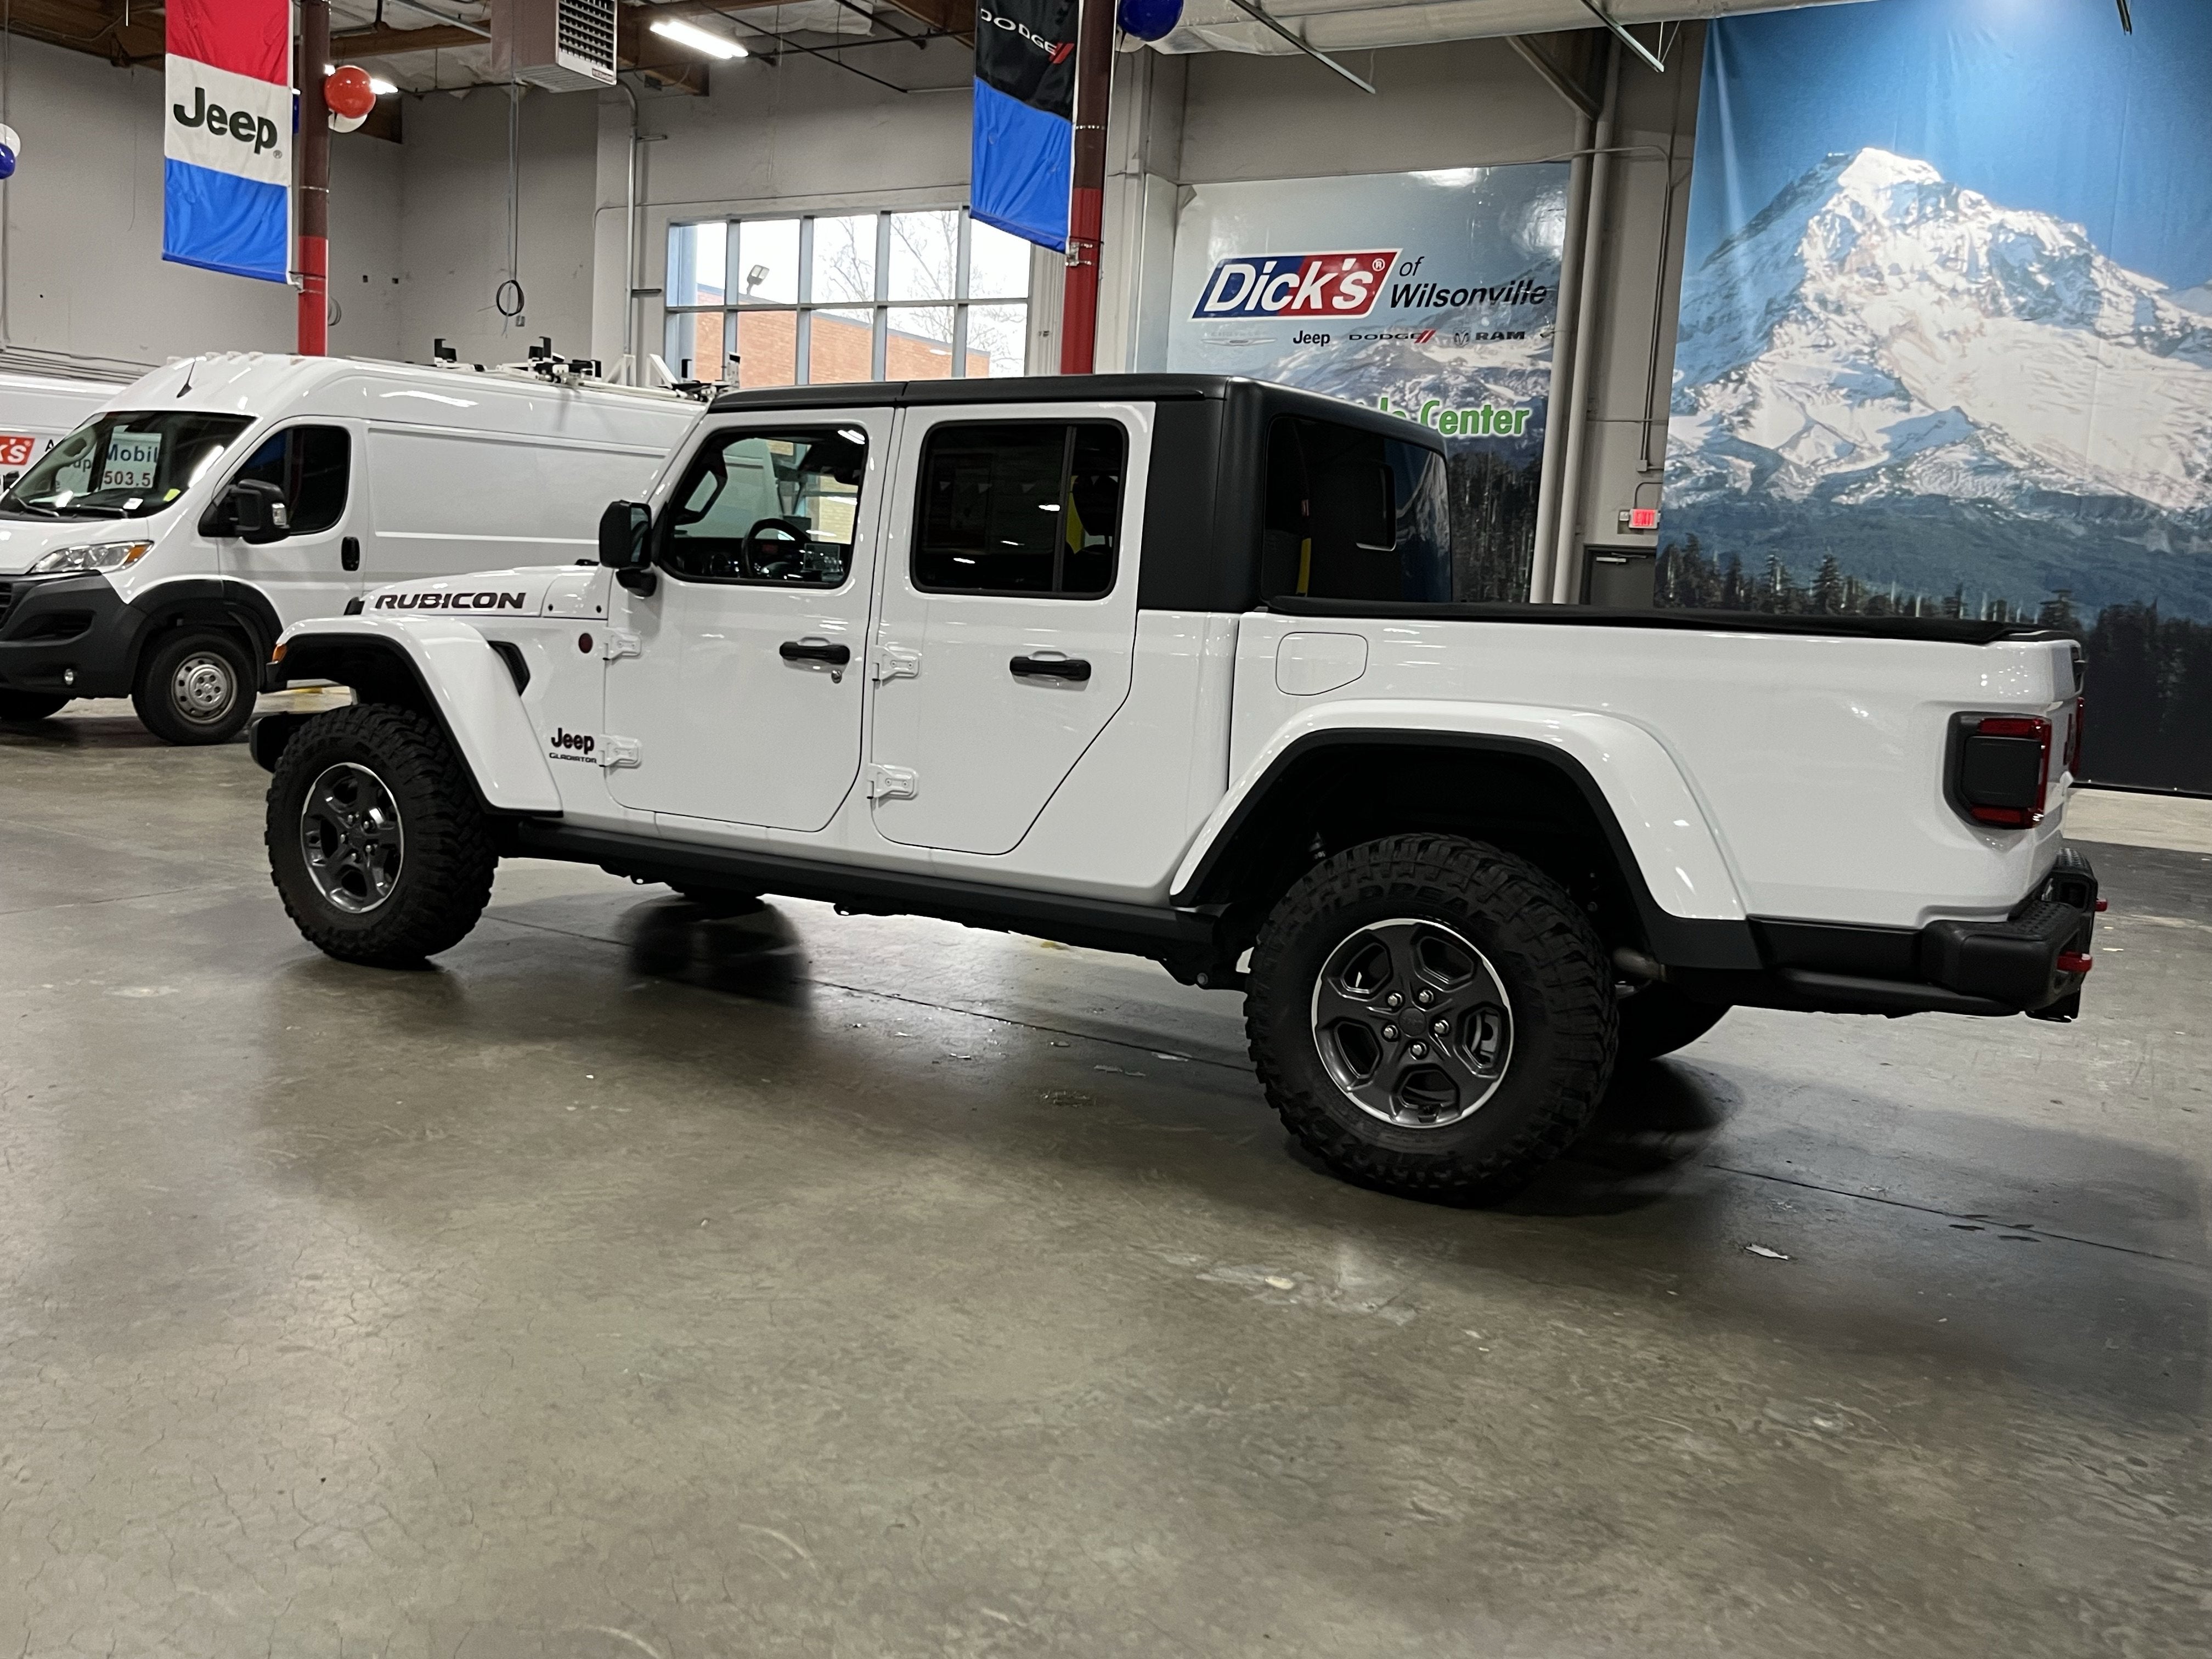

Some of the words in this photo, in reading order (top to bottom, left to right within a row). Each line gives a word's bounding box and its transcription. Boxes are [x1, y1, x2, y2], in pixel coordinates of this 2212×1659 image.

[980, 8, 1057, 56] DODGE
[173, 87, 278, 155] Jeep
[1400, 256, 1425, 276] of
[1390, 279, 1547, 308] Wilsonville
[1293, 330, 1330, 346] Jeep
[1475, 331, 1525, 341] RAM
[1634, 511, 1655, 526] EXIT
[375, 592, 527, 609] RUBICON
[551, 727, 595, 755] Jeep
[549, 752, 597, 763] GLADIATOR
